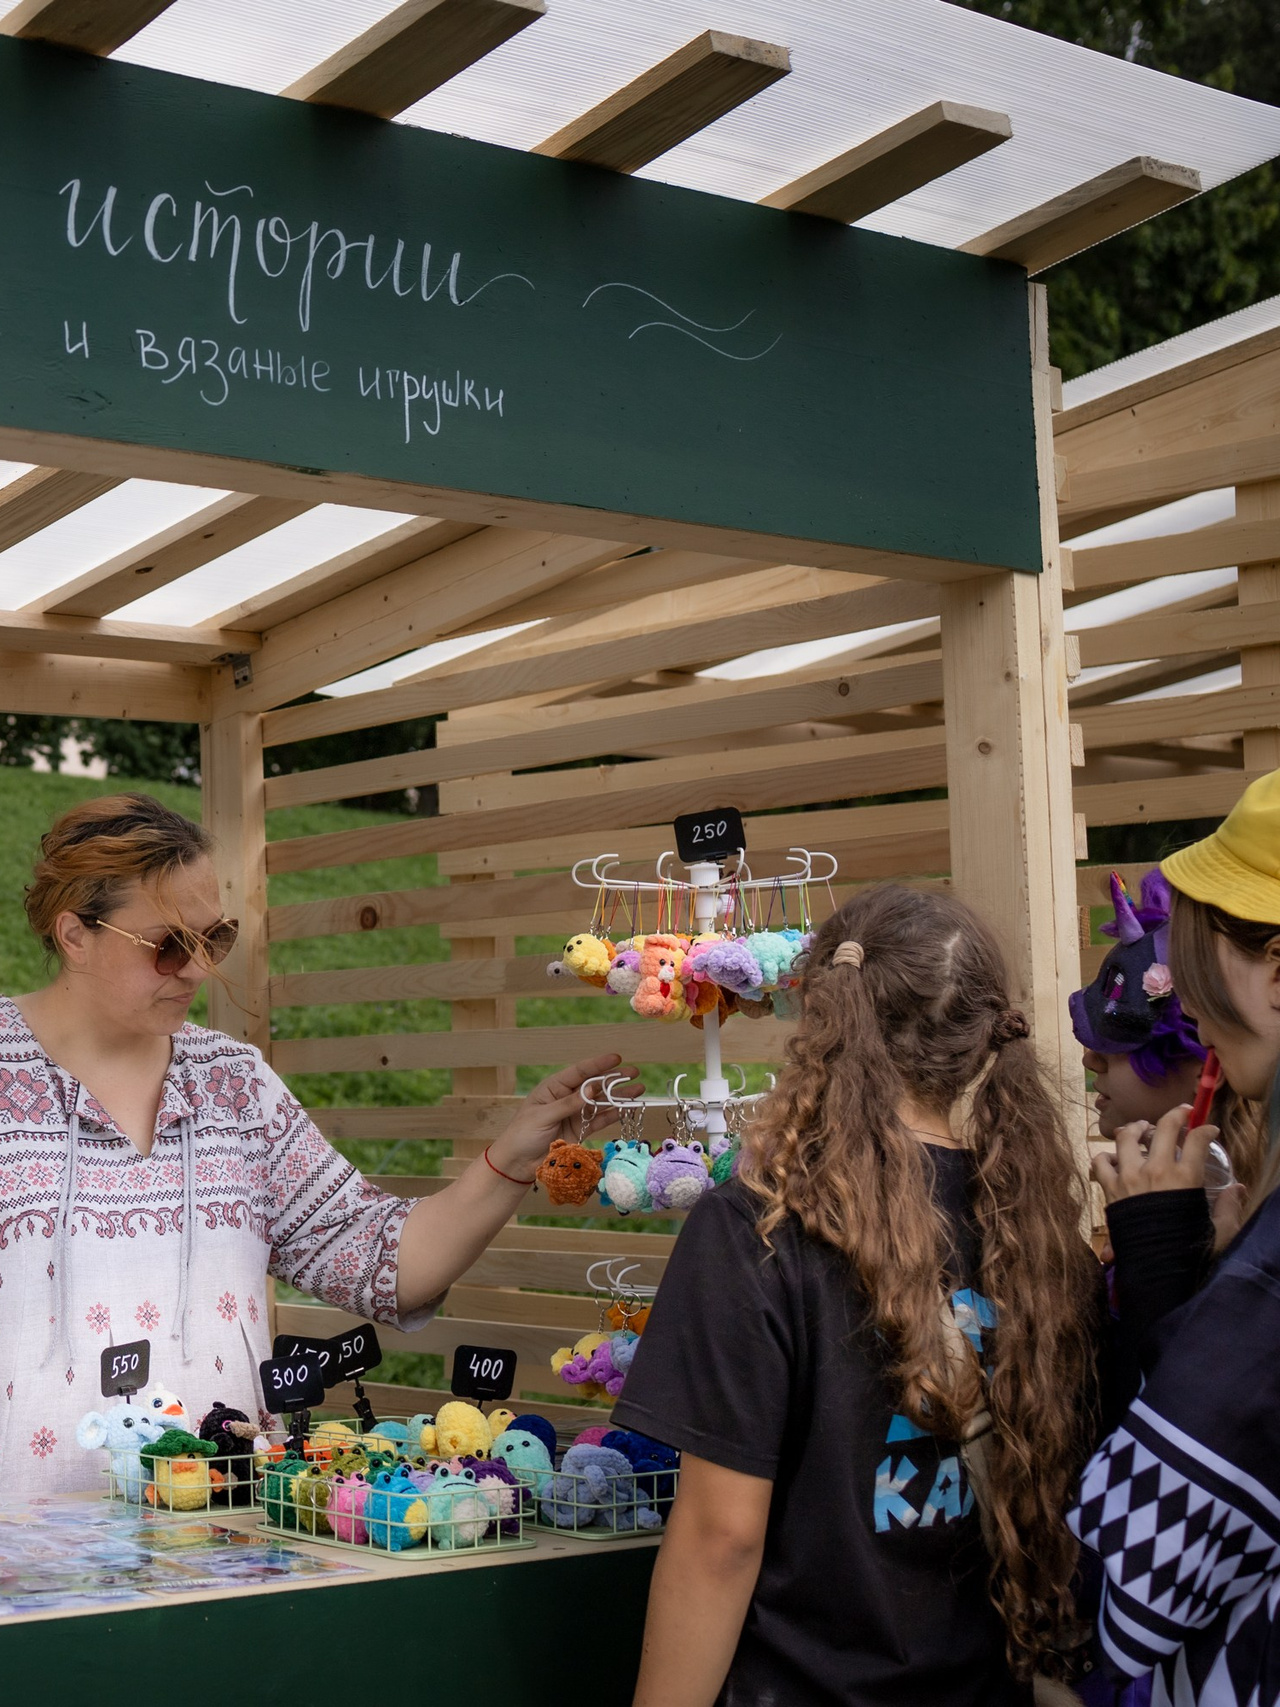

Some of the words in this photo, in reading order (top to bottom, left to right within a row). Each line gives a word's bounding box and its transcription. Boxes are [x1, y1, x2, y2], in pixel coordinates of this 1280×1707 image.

[58, 178, 536, 333] истории
[64, 320, 90, 359] и
[135, 328, 332, 406] вязаные
[358, 364, 504, 444] игрушки
[691, 820, 728, 844] 250
[337, 1334, 365, 1364] 50
[110, 1353, 139, 1379] 550
[271, 1364, 309, 1390] 300
[469, 1353, 504, 1380] 400
